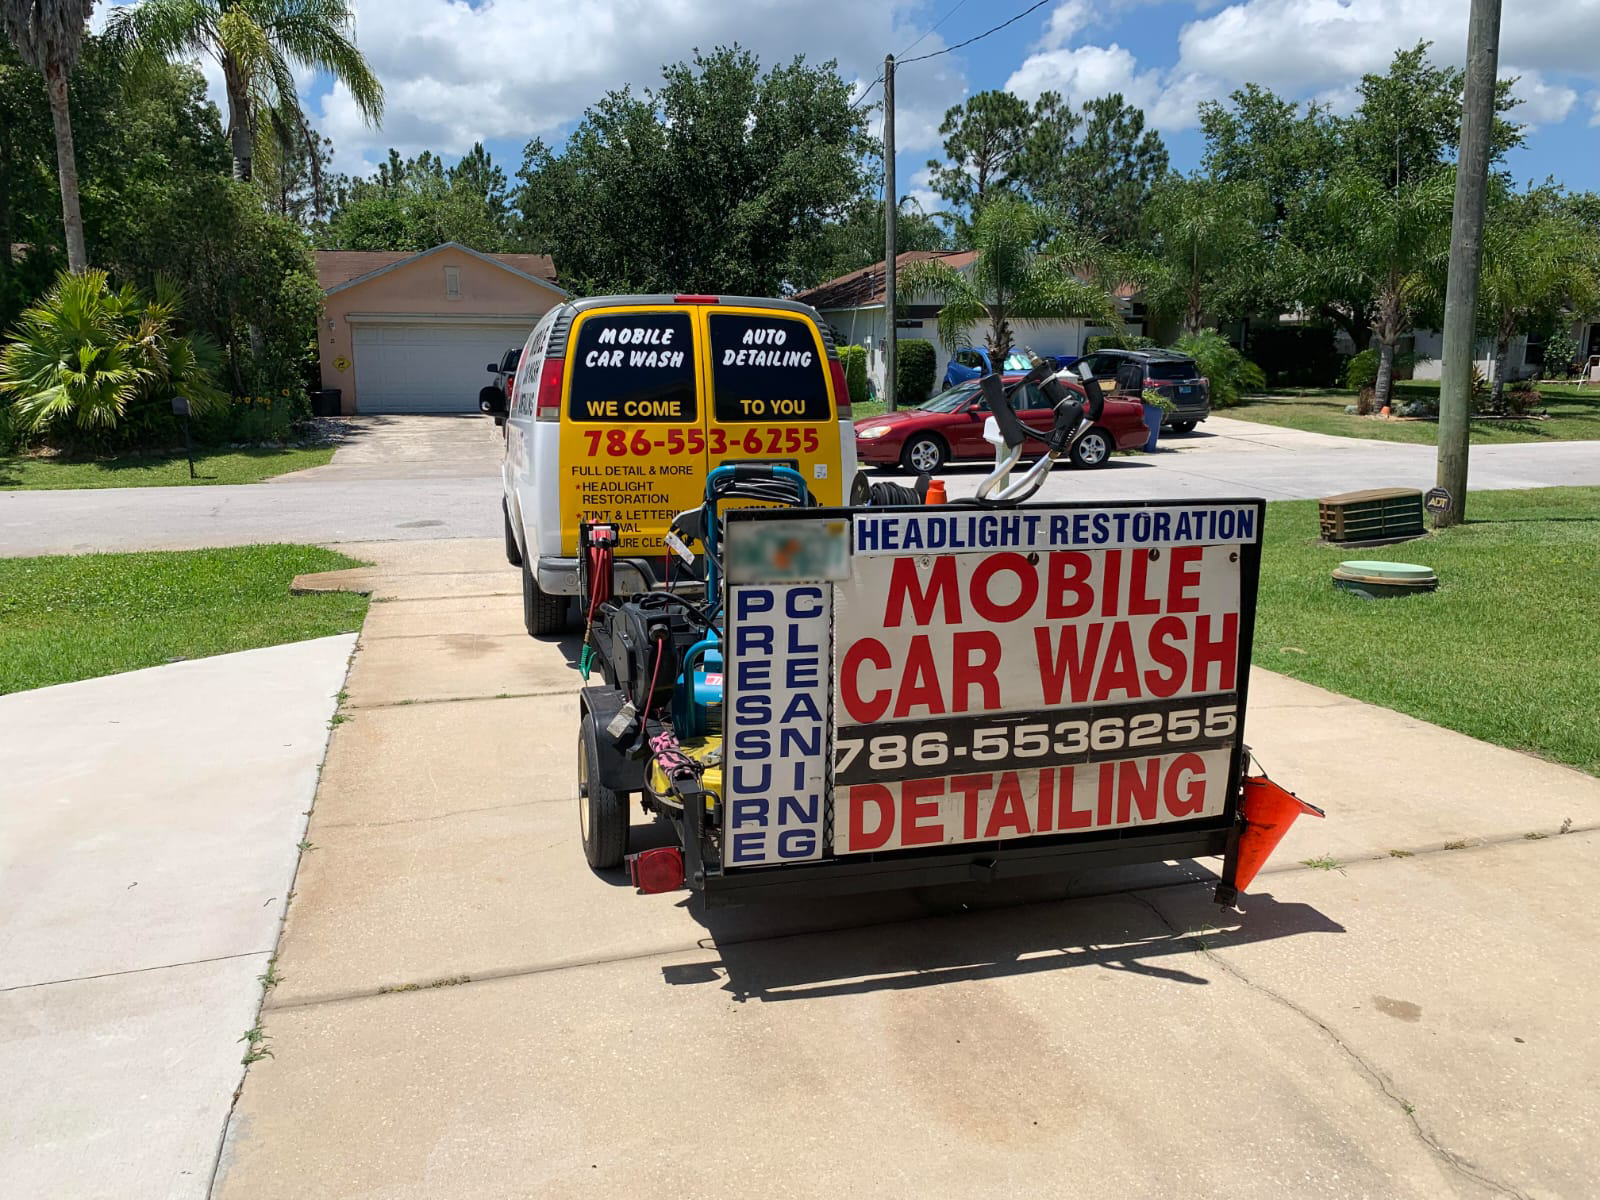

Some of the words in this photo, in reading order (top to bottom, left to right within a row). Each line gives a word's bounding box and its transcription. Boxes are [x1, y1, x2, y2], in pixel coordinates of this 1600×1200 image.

[598, 327, 674, 345] MOBILE
[742, 328, 787, 346] AUTO
[585, 350, 625, 368] CAR
[629, 350, 684, 368] WASH
[722, 349, 812, 368] DETAILING
[586, 400, 618, 417] WE
[624, 400, 682, 417] COME
[740, 399, 765, 415] TO
[770, 399, 806, 415] YOU
[583, 427, 820, 457] 786-553-6255
[571, 466, 602, 476] FULL
[605, 466, 646, 476] DETAIL
[648, 466, 657, 475] &
[660, 465, 693, 475] MORE
[582, 481, 654, 492] HEADLIGHT
[582, 494, 669, 505] RESTORATION
[1427, 496, 1448, 508] ADT
[583, 510, 611, 520] TINT
[615, 510, 622, 520] &
[626, 509, 685, 520] LETTERI
[858, 515, 1042, 551] HEADLIGHT
[1050, 509, 1254, 545] RESTORATION
[883, 546, 1204, 628] MOBILE
[840, 630, 1003, 724] CAR
[1034, 612, 1239, 705] WASH
[732, 590, 775, 863] PRESSURE
[777, 586, 824, 859] CLEANING
[848, 752, 1207, 852] DETAILING
